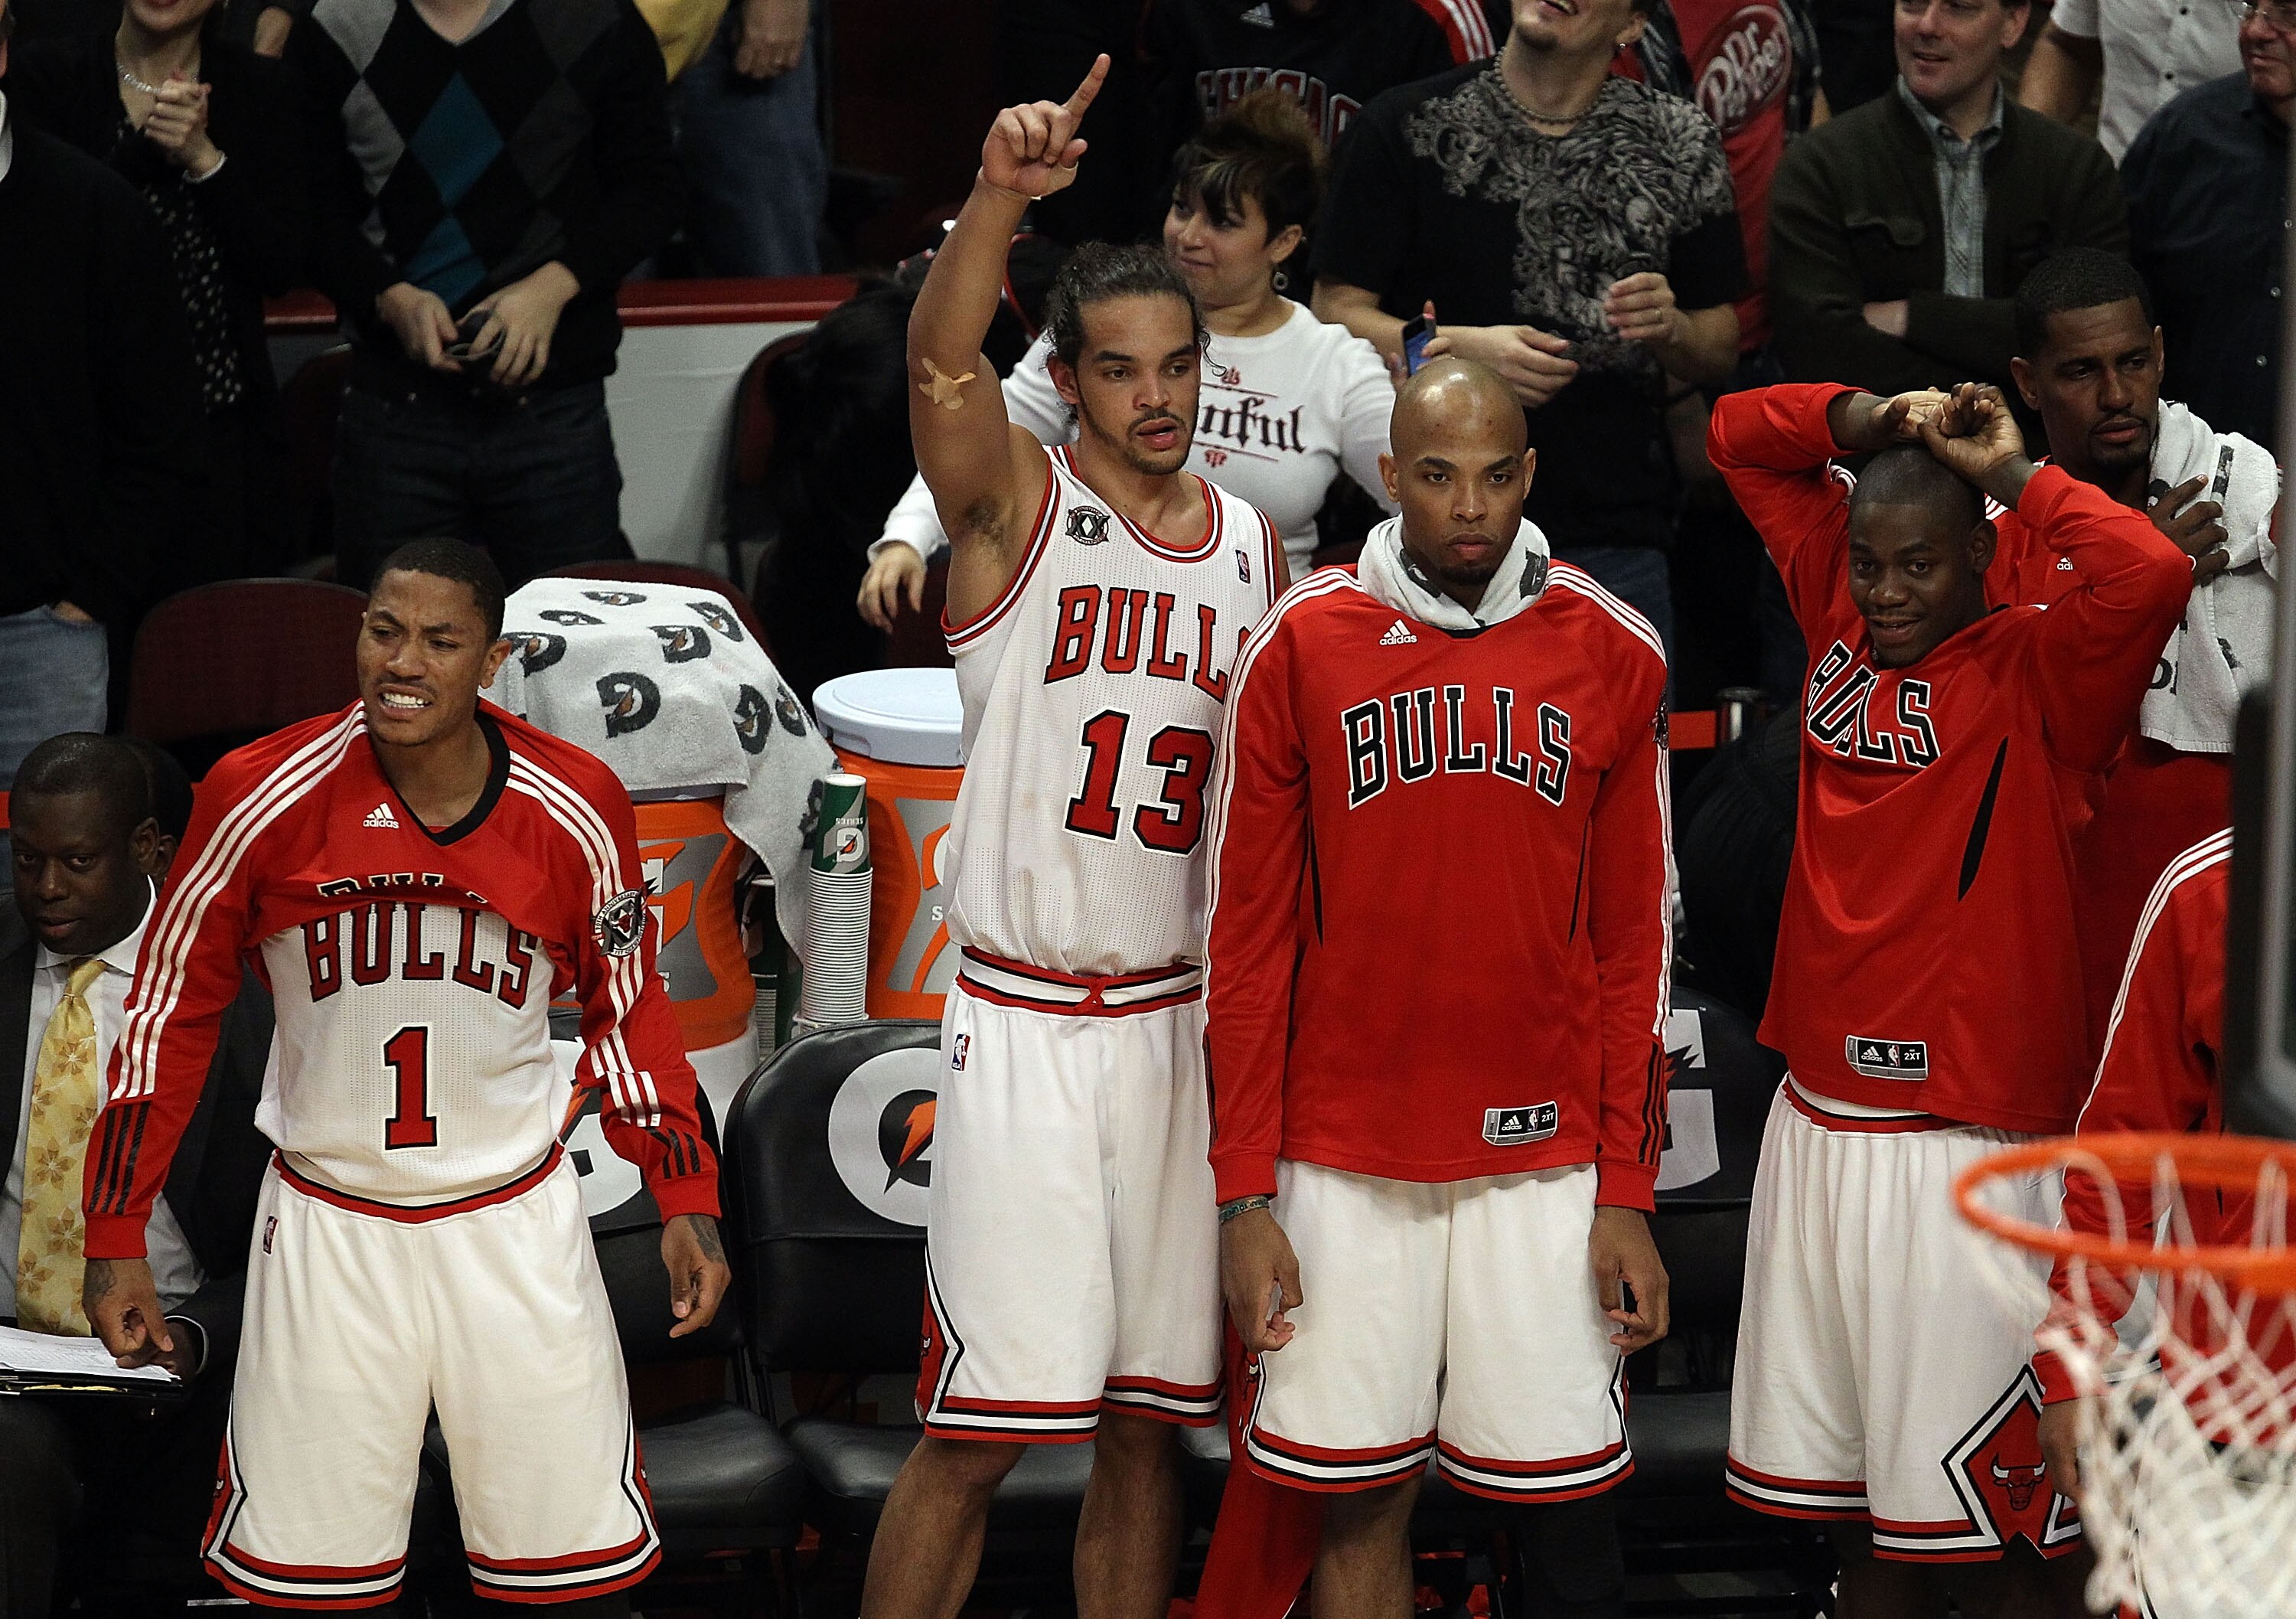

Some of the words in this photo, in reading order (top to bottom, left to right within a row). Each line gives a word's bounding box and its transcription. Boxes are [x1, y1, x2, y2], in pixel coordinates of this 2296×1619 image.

[1199, 397, 1306, 453] nful
[2056, 561, 2073, 570] adi
[1043, 584, 1254, 706] BULL
[1379, 634, 1417, 646] adidas
[1341, 684, 1571, 811] BULLS
[1806, 639, 1942, 769] BULS
[363, 818, 400, 829] adidas
[1062, 704, 1218, 859] 13
[301, 901, 538, 1010] BULLS
[382, 1022, 439, 1151] 1
[1541, 1112, 1554, 1122] 2XT
